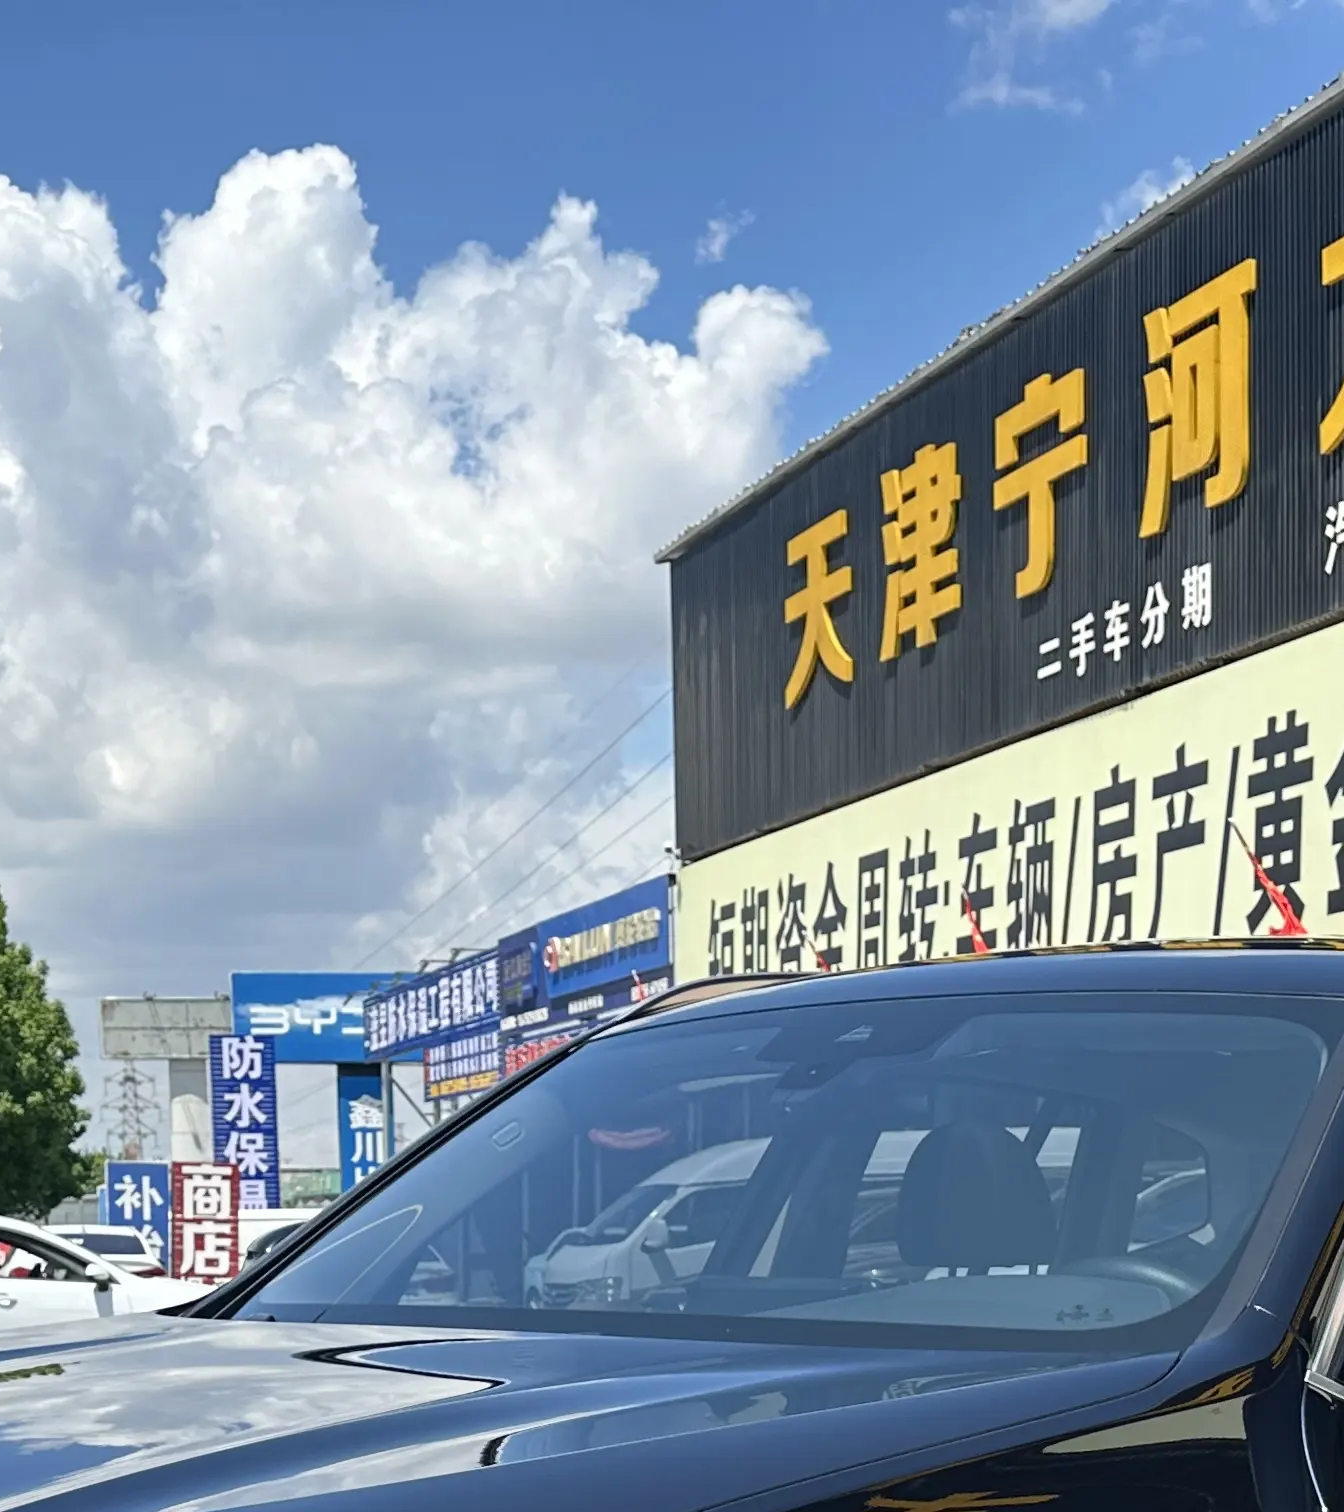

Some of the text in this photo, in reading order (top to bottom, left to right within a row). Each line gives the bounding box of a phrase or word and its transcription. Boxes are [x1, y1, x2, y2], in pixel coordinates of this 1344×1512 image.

[1036, 561, 1213, 680] 二手车分期
